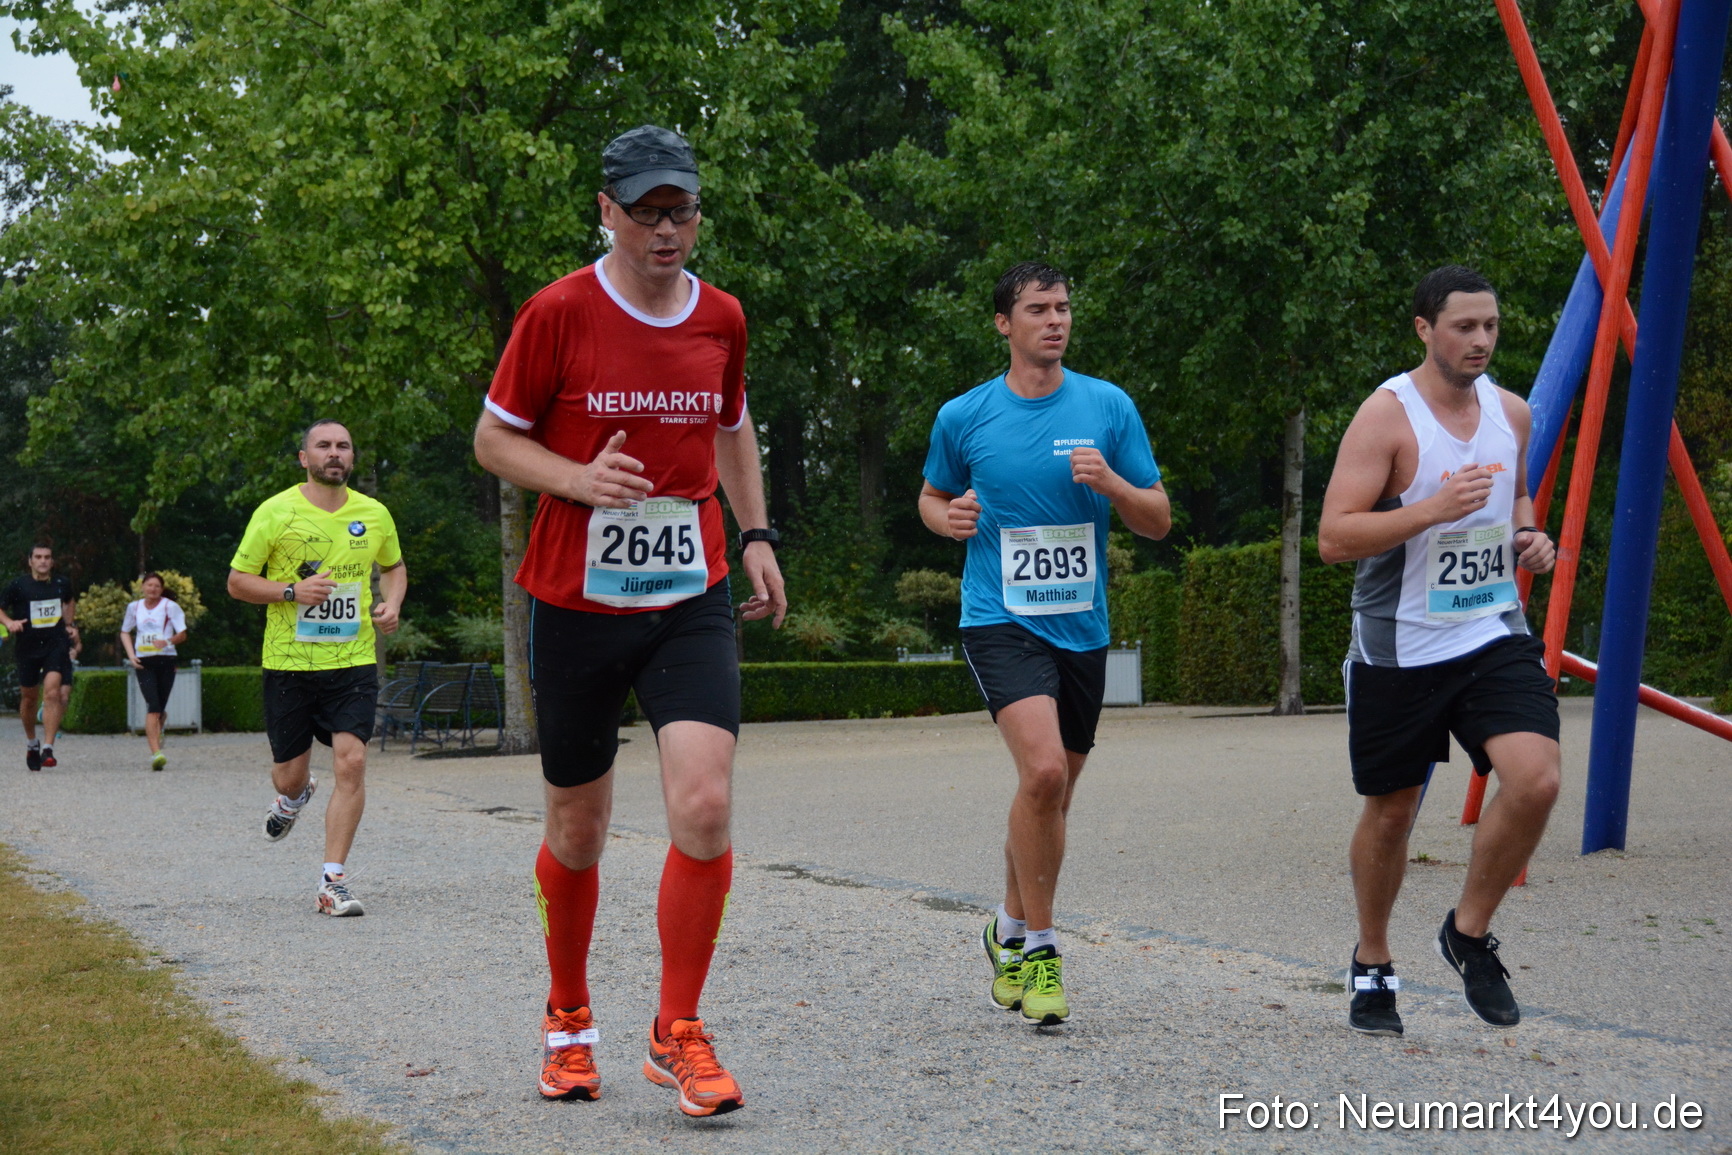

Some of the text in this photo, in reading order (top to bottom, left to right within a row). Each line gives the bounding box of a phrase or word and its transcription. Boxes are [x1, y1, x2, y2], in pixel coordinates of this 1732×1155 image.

[587, 391, 710, 412] NEUMARKT
[1060, 438, 1095, 446] PFLEIDERER
[645, 501, 692, 514] BOCK
[1042, 527, 1087, 539] BOCK
[600, 524, 695, 567] 2645
[343, 563, 361, 571] NEXT
[1013, 545, 1088, 581] 2693
[1438, 544, 1505, 585] 2534
[334, 571, 347, 579] 100
[620, 577, 673, 594] Jürgen
[1026, 588, 1078, 602] Matthias
[1452, 591, 1494, 609] Andreas
[38, 606, 56, 617] 182
[303, 597, 356, 620] 2905
[318, 625, 341, 635] Erich
